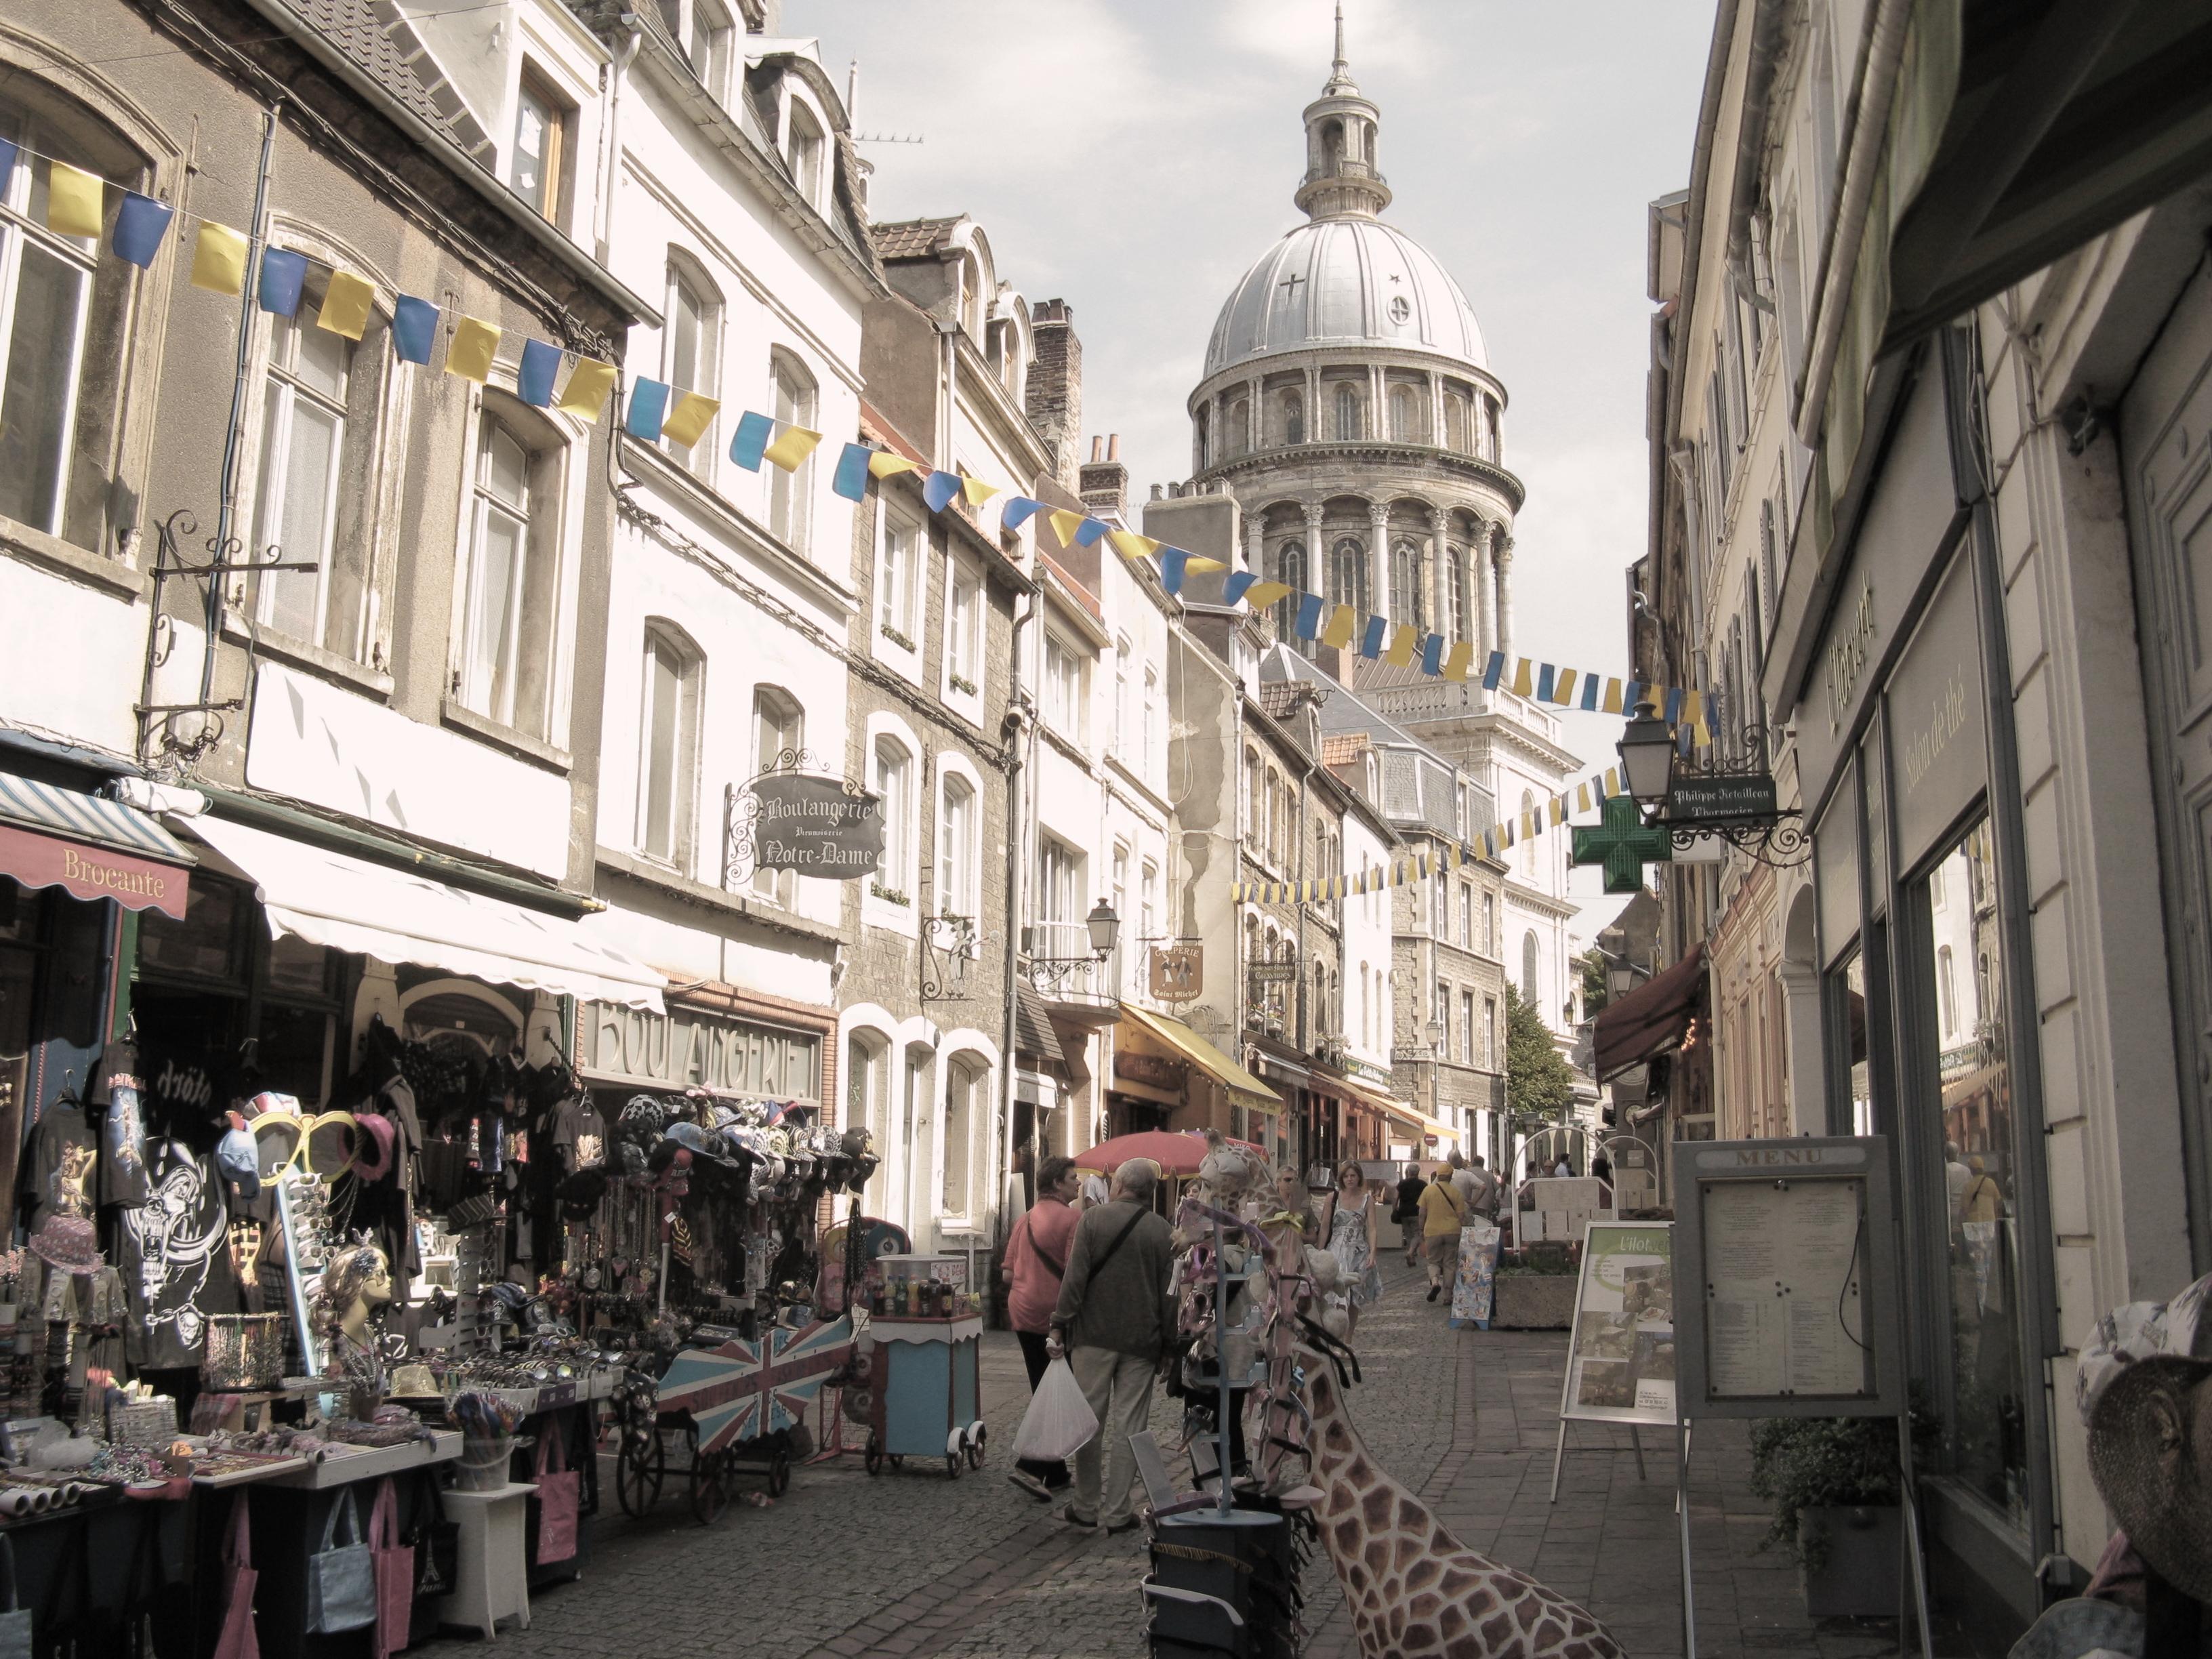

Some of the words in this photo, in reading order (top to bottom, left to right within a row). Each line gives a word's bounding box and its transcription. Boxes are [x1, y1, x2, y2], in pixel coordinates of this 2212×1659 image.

[1905, 730, 1931, 794] Salon
[1931, 702, 1946, 758] de
[1944, 663, 1967, 741] thé
[1674, 790, 1716, 805] Philippe
[766, 797, 873, 827] Boulangerie
[794, 826, 843, 838] Viennoiserie
[765, 839, 873, 865] Notre-Dame
[63, 847, 165, 899] Brocante
[1153, 989, 1173, 998] Saint
[1174, 989, 1199, 999] Michel
[596, 1002, 798, 1097] BOULANGERIE
[1736, 1148, 1824, 1166] MENU
